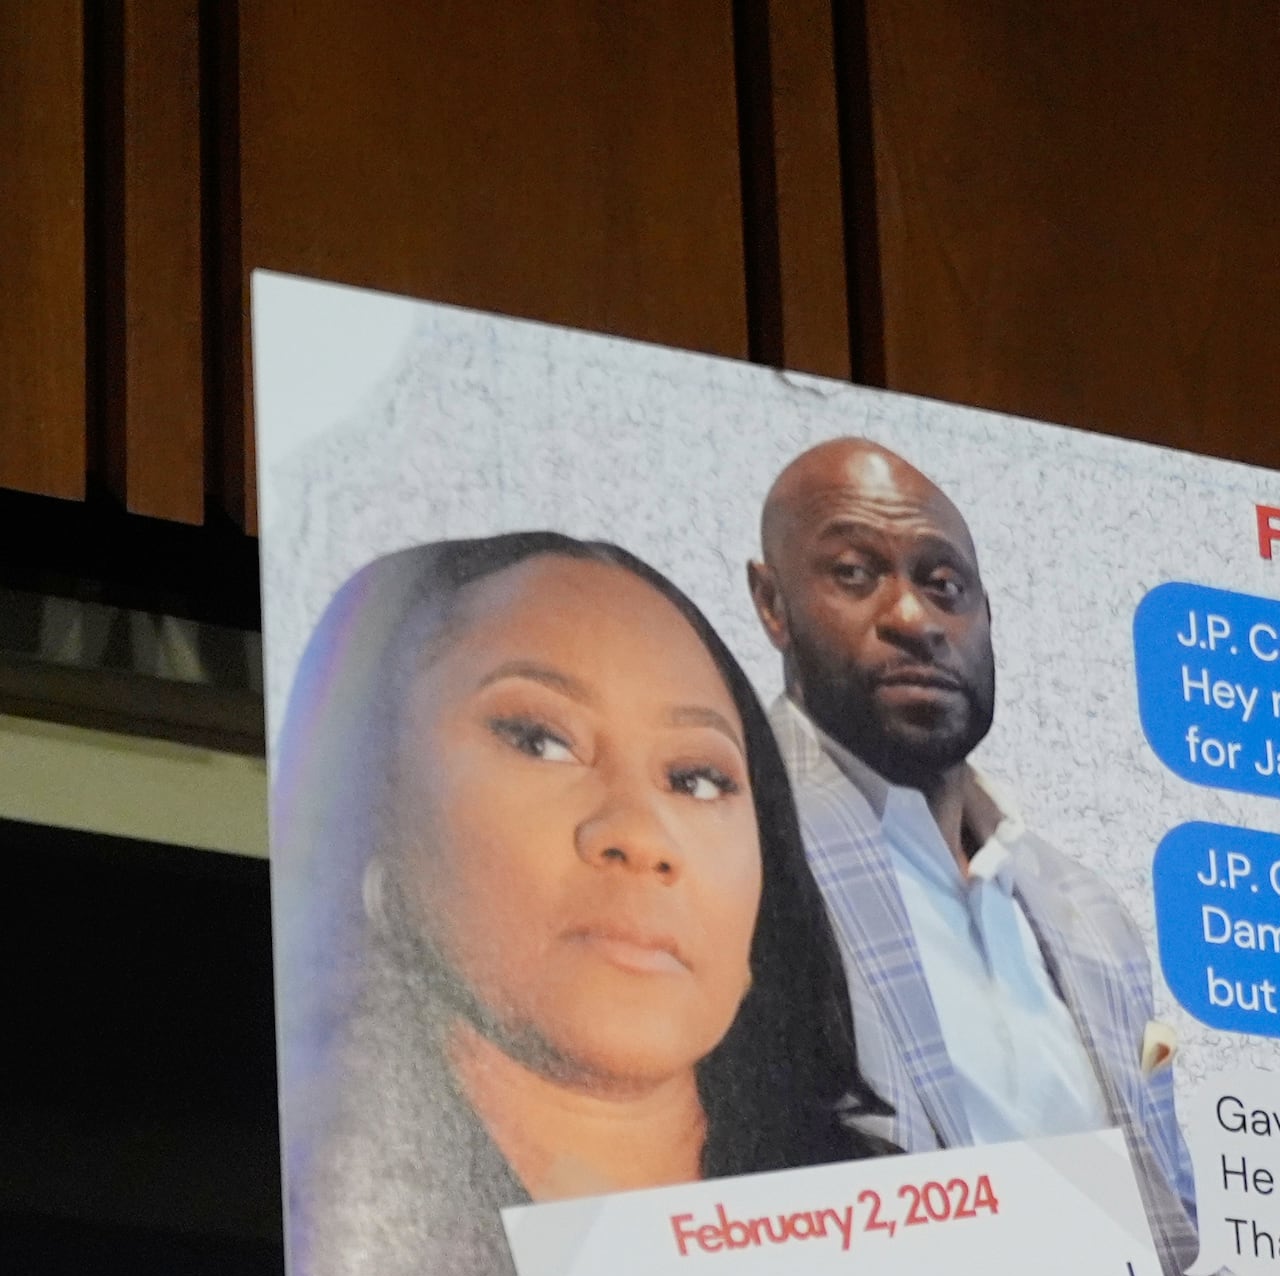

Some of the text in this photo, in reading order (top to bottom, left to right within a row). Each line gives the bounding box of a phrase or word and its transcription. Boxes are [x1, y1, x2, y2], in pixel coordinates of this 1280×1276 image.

[1176, 610, 1237, 655] J.P.
[1180, 664, 1259, 722] Hey
[1184, 724, 1242, 769] for
[1196, 848, 1258, 893] J.P.
[1206, 965, 1277, 1014] but
[1220, 1153, 1274, 1195] He
[670, 1203, 854, 1256] February
[897, 1174, 1000, 1226] 2024
